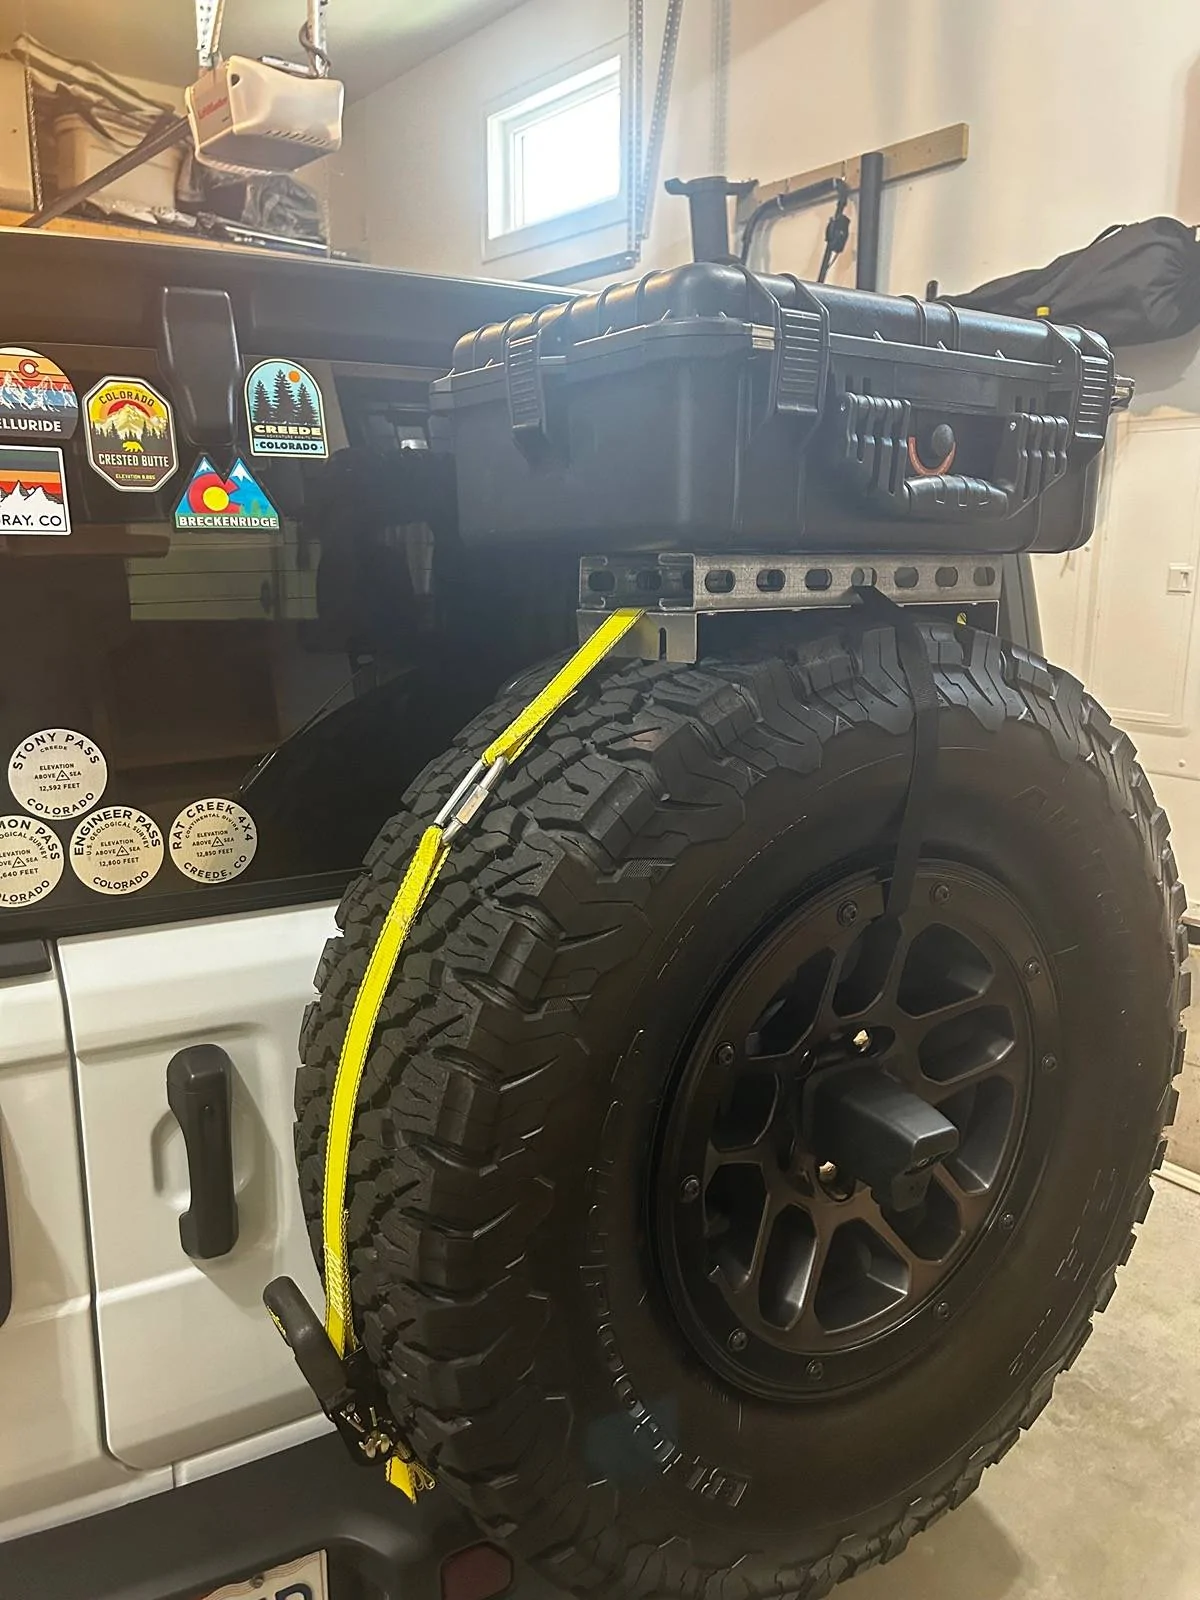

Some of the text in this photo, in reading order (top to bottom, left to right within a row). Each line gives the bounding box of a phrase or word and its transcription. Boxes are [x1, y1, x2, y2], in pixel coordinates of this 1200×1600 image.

[99, 391, 155, 407] COLORADO
[0, 418, 62, 432] LLURIDE
[254, 425, 321, 436] CREEDE
[260, 442, 318, 450] COLORADO
[98, 453, 170, 467] CRESTED BUTTE
[39, 515, 62, 527] CO
[179, 517, 277, 527] BRECKENRIDGE
[13, 732, 100, 770] STONY PASS
[40, 745, 68, 753] CREEDE
[39, 763, 75, 771] ELEVATION
[27, 793, 94, 815] COLORADO
[74, 809, 161, 856] ENGINEER PASS
[172, 802, 254, 850] RAT CREEK 4X4
[185, 813, 239, 838] CONTINENTAL DIVIDE
[90, 821, 131, 841] GEOLOGICAL
[132, 825, 150, 849] SURVEY
[197, 830, 228, 838] ELEVATION
[28, 836, 48, 860] SURVEY
[35, 827, 60, 860] PASS
[100, 839, 134, 847] ELEVATION
[234, 855, 247, 869] CO
[20, 868, 38, 876] FEET
[93, 870, 149, 890] COLORADO
[0, 880, 50, 903] LORADO
